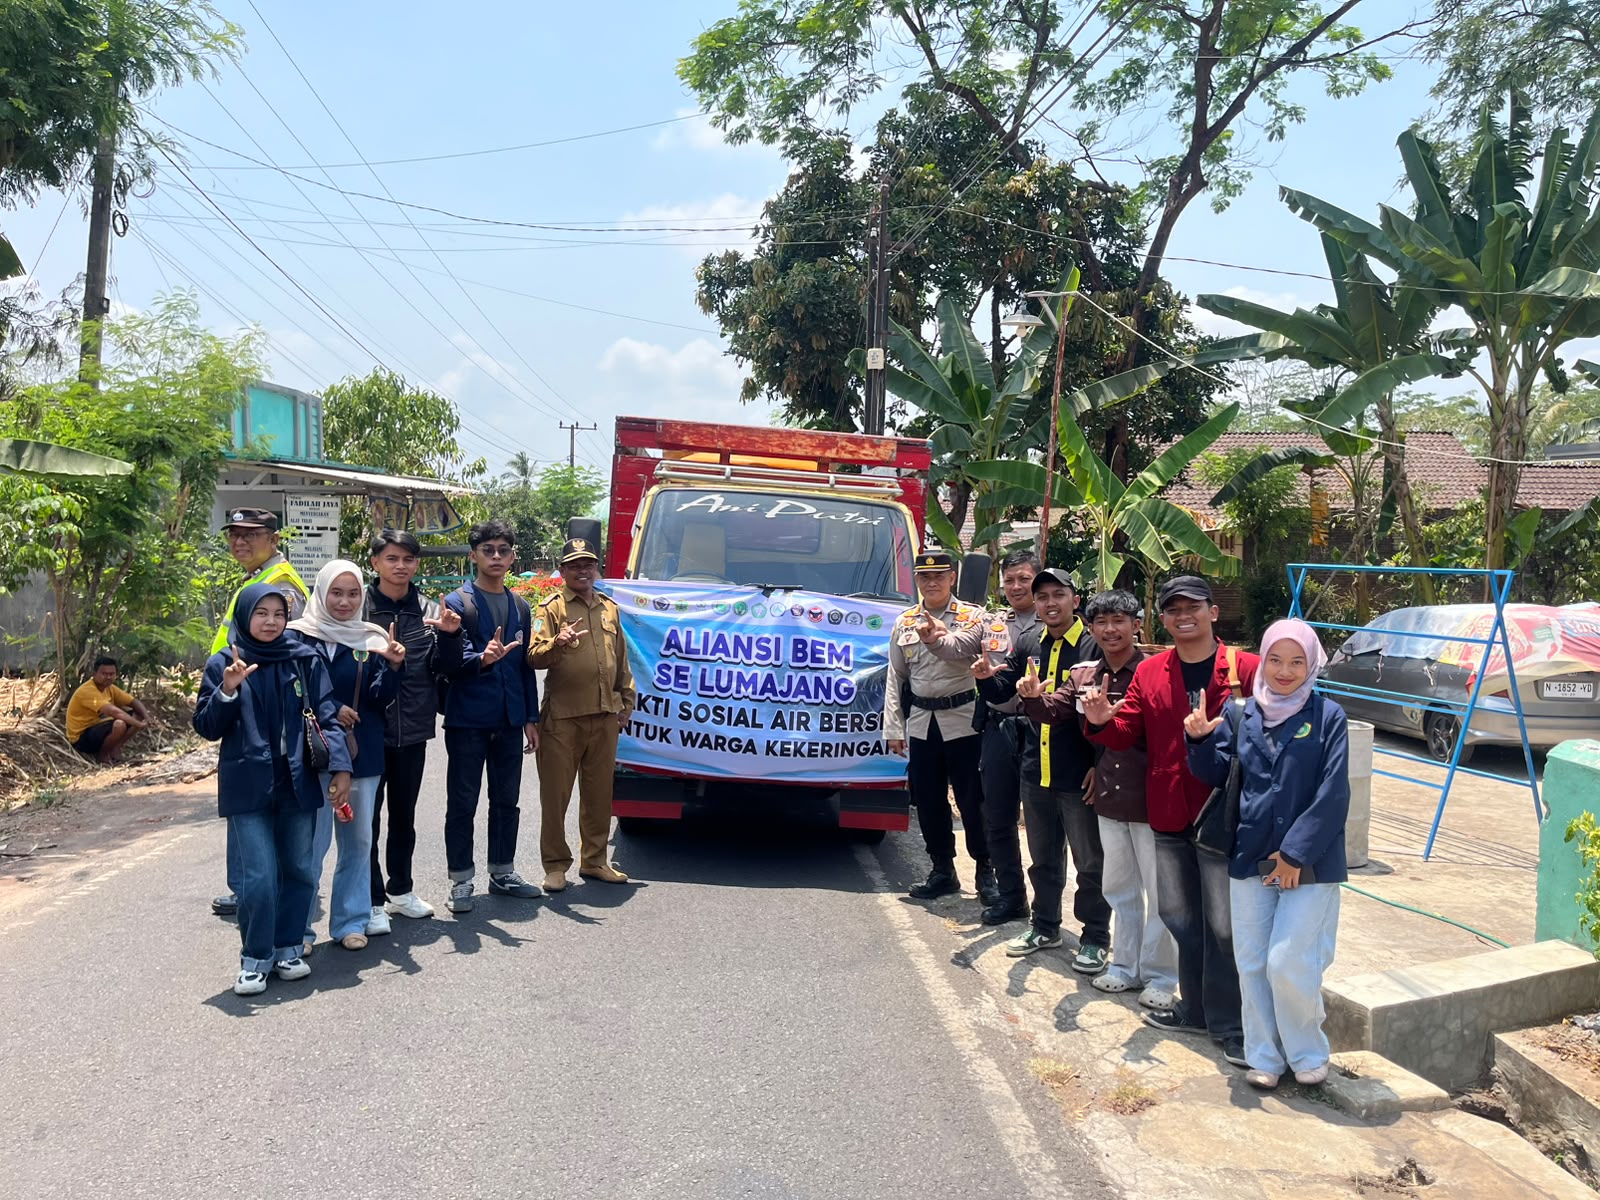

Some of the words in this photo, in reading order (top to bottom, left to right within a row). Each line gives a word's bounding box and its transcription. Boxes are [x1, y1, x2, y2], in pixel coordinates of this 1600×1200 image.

[662, 628, 782, 663] ALIANSI
[791, 636, 852, 668] BEM
[655, 662, 691, 690] SE
[699, 667, 855, 701] LUMAJANG
[1545, 683, 1551, 692] N
[1558, 683, 1577, 693] 1852
[632, 692, 671, 718] KTI
[678, 702, 764, 730] SOSIAL
[770, 709, 811, 733] AIR
[619, 719, 672, 744] NTUK
[679, 730, 757, 756] WARGA
